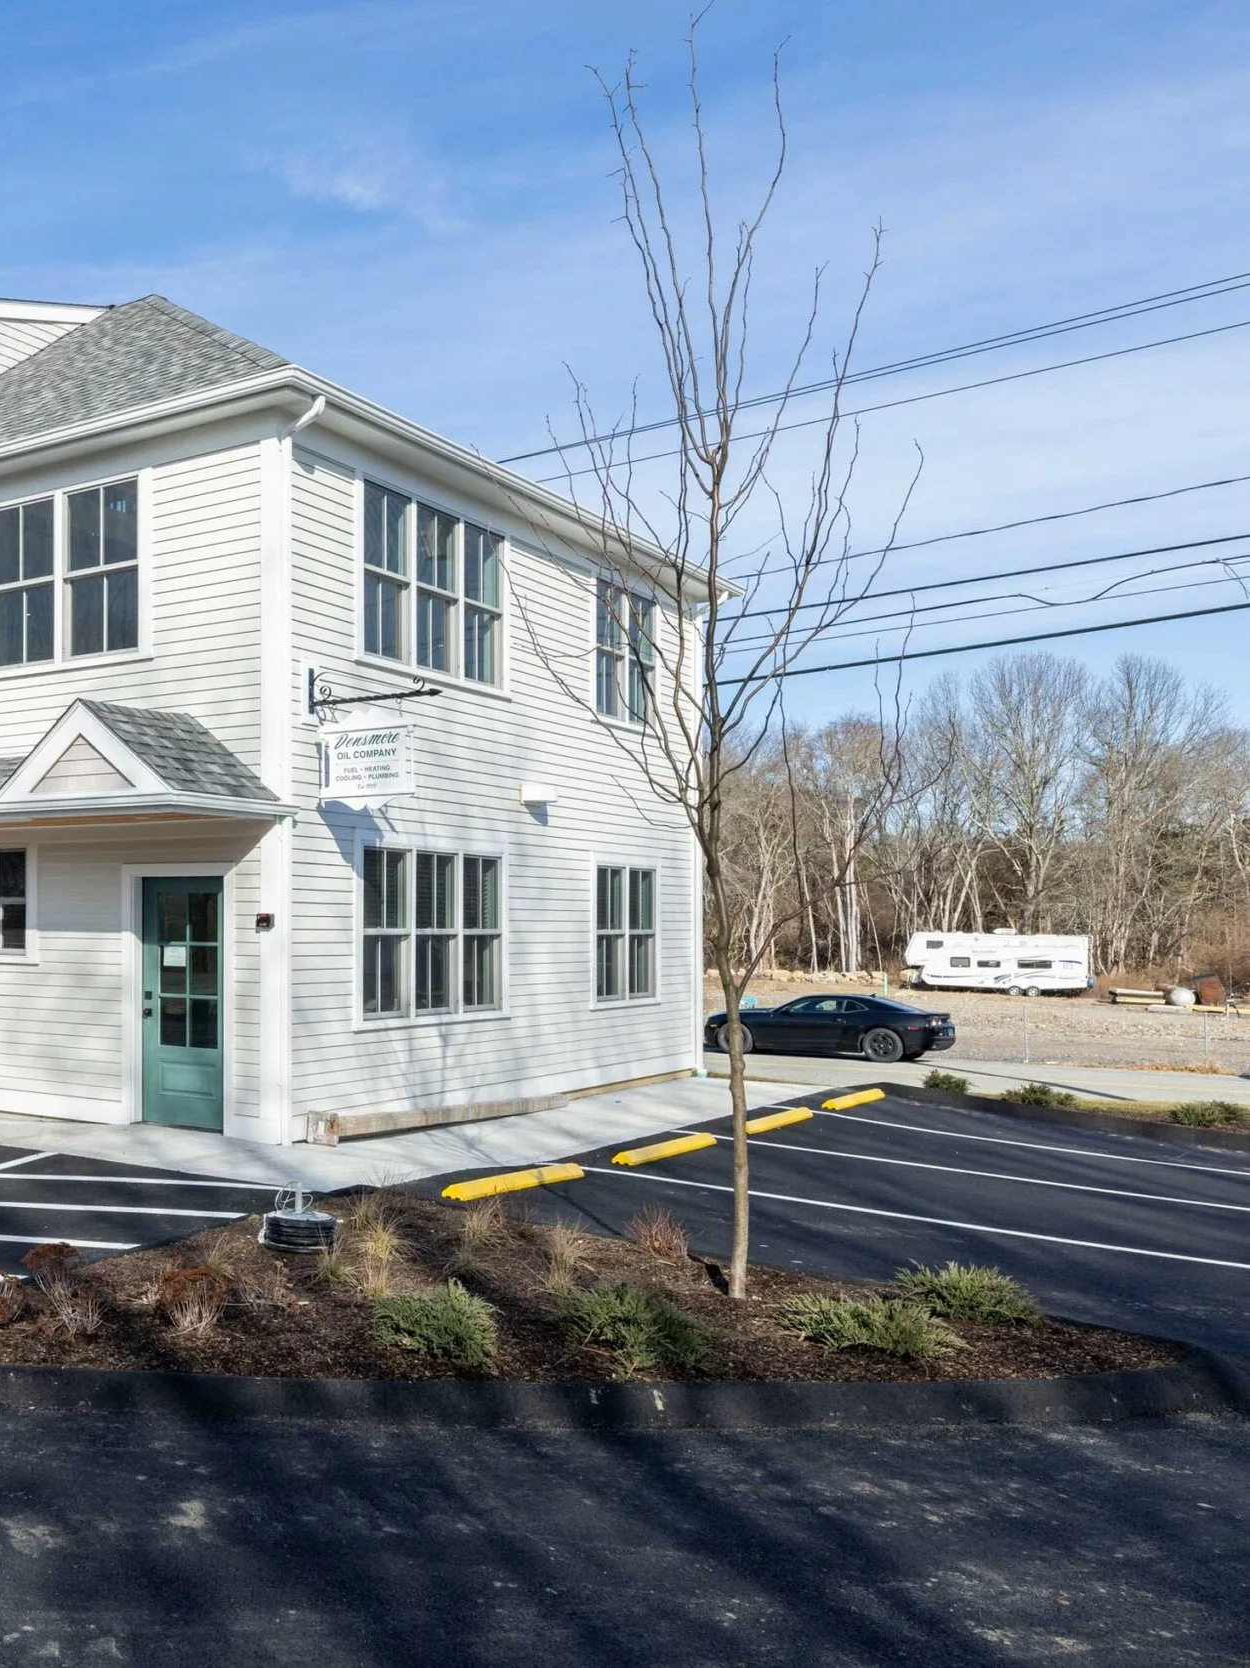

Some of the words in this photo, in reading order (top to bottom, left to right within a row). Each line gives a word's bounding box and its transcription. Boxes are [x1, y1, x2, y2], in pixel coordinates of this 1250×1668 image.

[334, 731, 400, 749] Densmore
[337, 752, 351, 760] OIL
[353, 748, 397, 759] COMPANY
[364, 764, 390, 772] HEATING
[336, 774, 362, 782] COOLING
